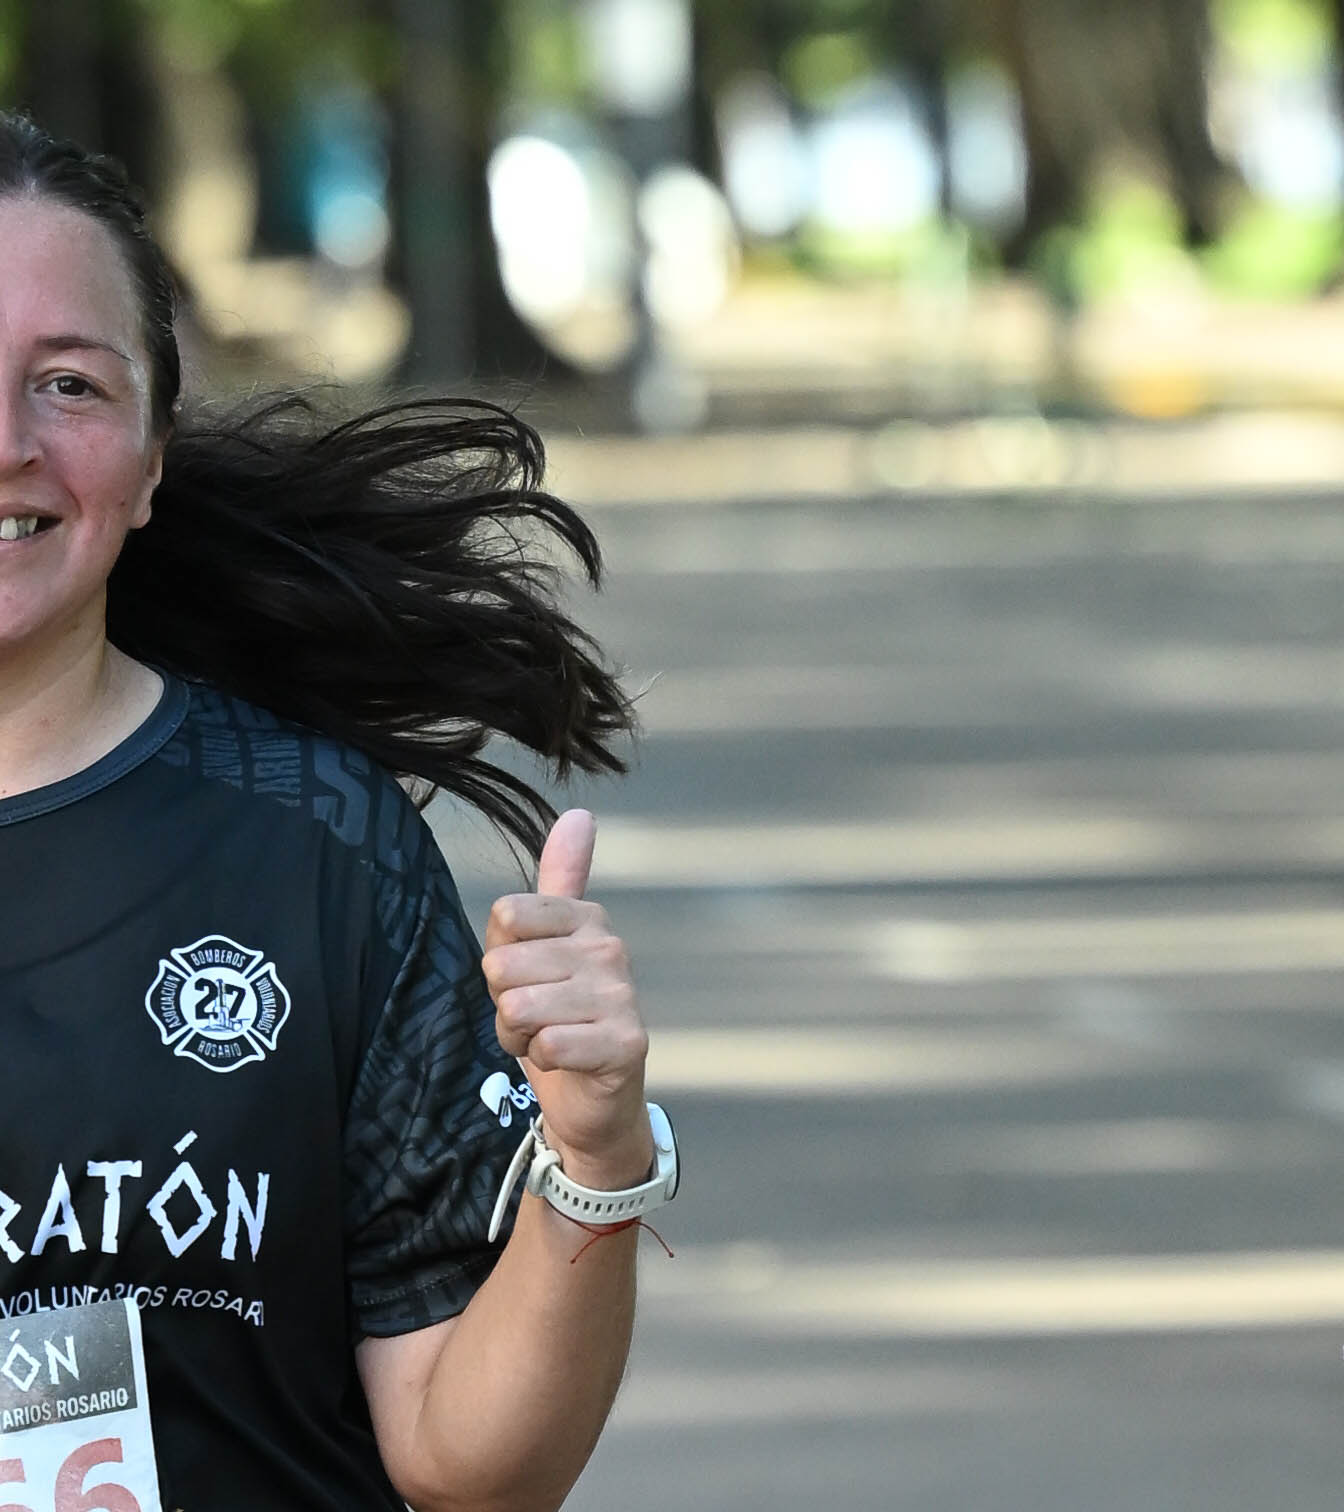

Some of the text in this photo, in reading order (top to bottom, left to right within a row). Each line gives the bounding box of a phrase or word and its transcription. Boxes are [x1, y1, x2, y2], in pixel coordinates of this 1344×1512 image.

[190, 948, 247, 968] BOMBEROS
[194, 977, 247, 1020] 27
[255, 976, 277, 1034] VOLUNTARIOS
[197, 1040, 242, 1059] ROSARIO
[56, 1388, 129, 1419] ROSARIO
